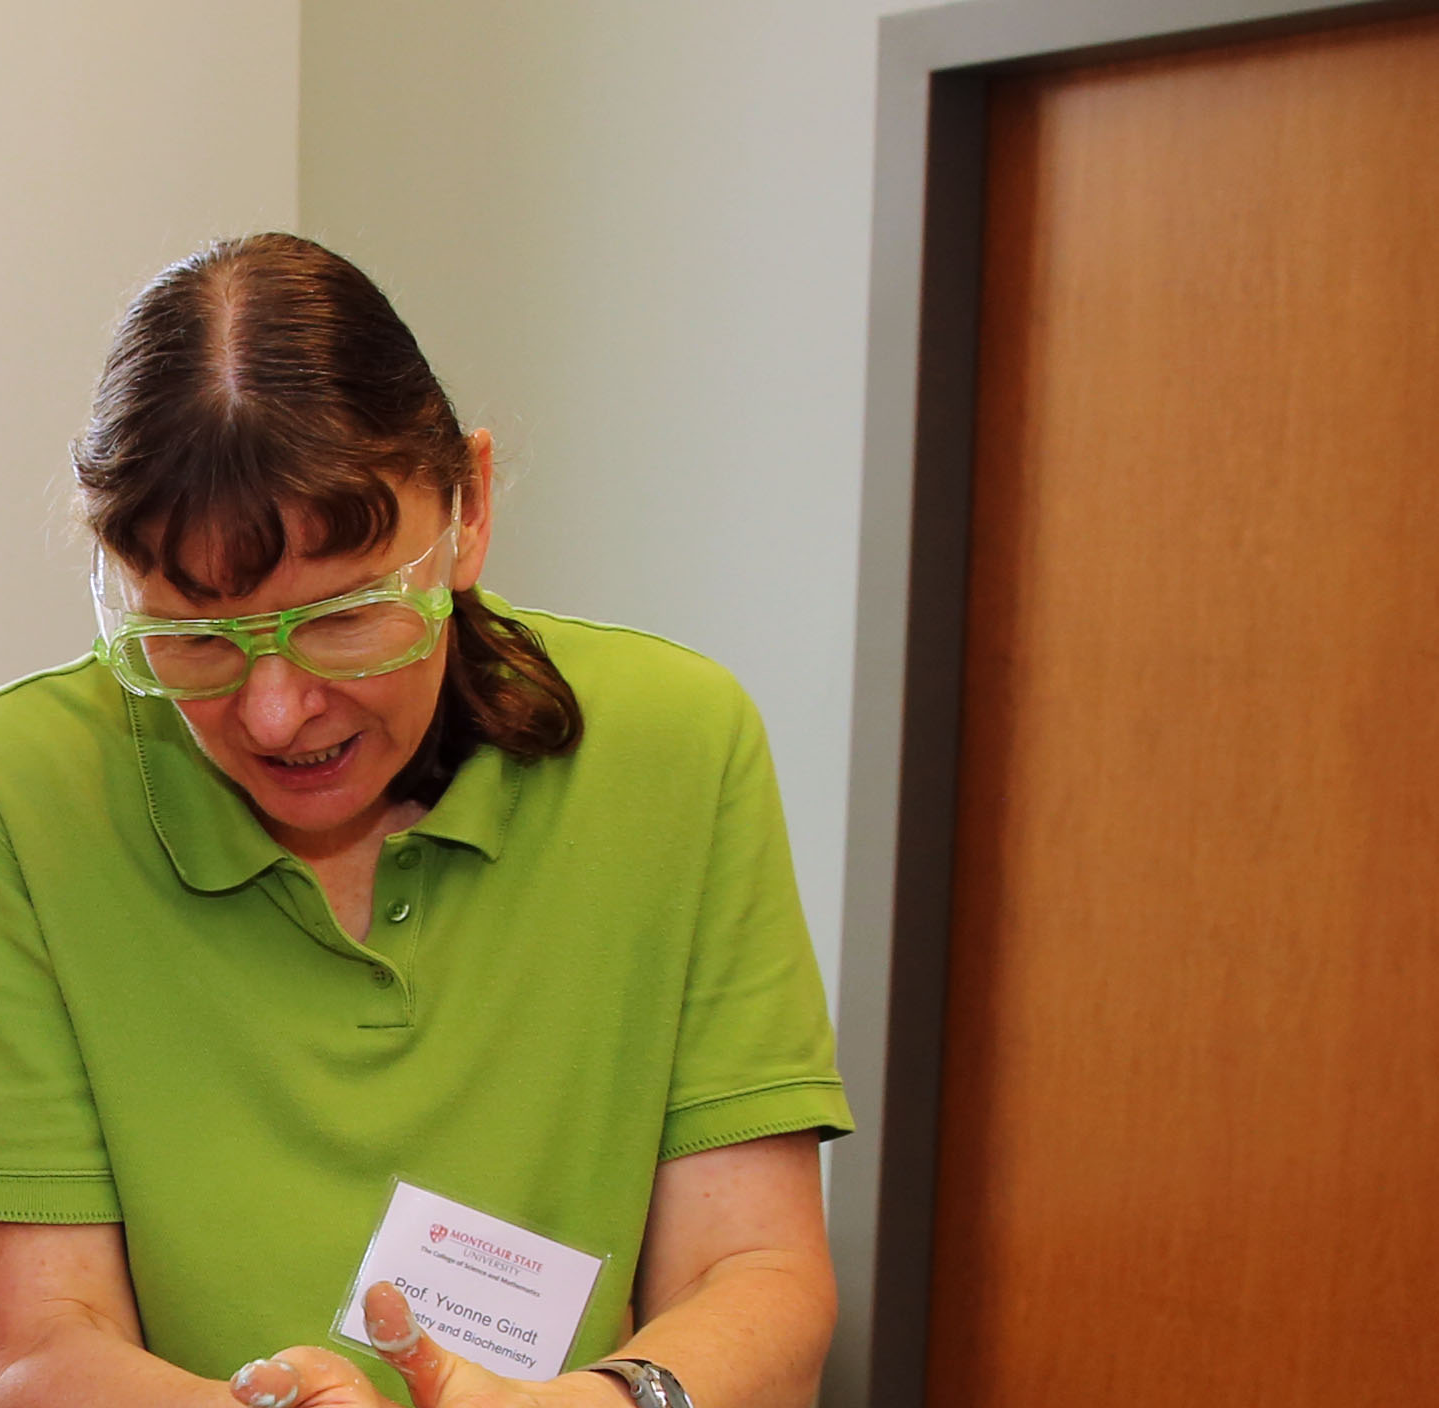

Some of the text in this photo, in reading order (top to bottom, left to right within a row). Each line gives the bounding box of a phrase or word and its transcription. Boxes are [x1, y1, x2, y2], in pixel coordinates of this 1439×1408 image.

[421, 1245, 432, 1254] The
[433, 1250, 455, 1264] College
[450, 1230, 543, 1273] MONTCLAIR STATE
[463, 1248, 521, 1276] UNIVERSITY
[394, 1277, 538, 1346] Prof. Yvonne Gindt
[437, 1322, 460, 1338] and
[462, 1330, 537, 1370] Biochemistry
